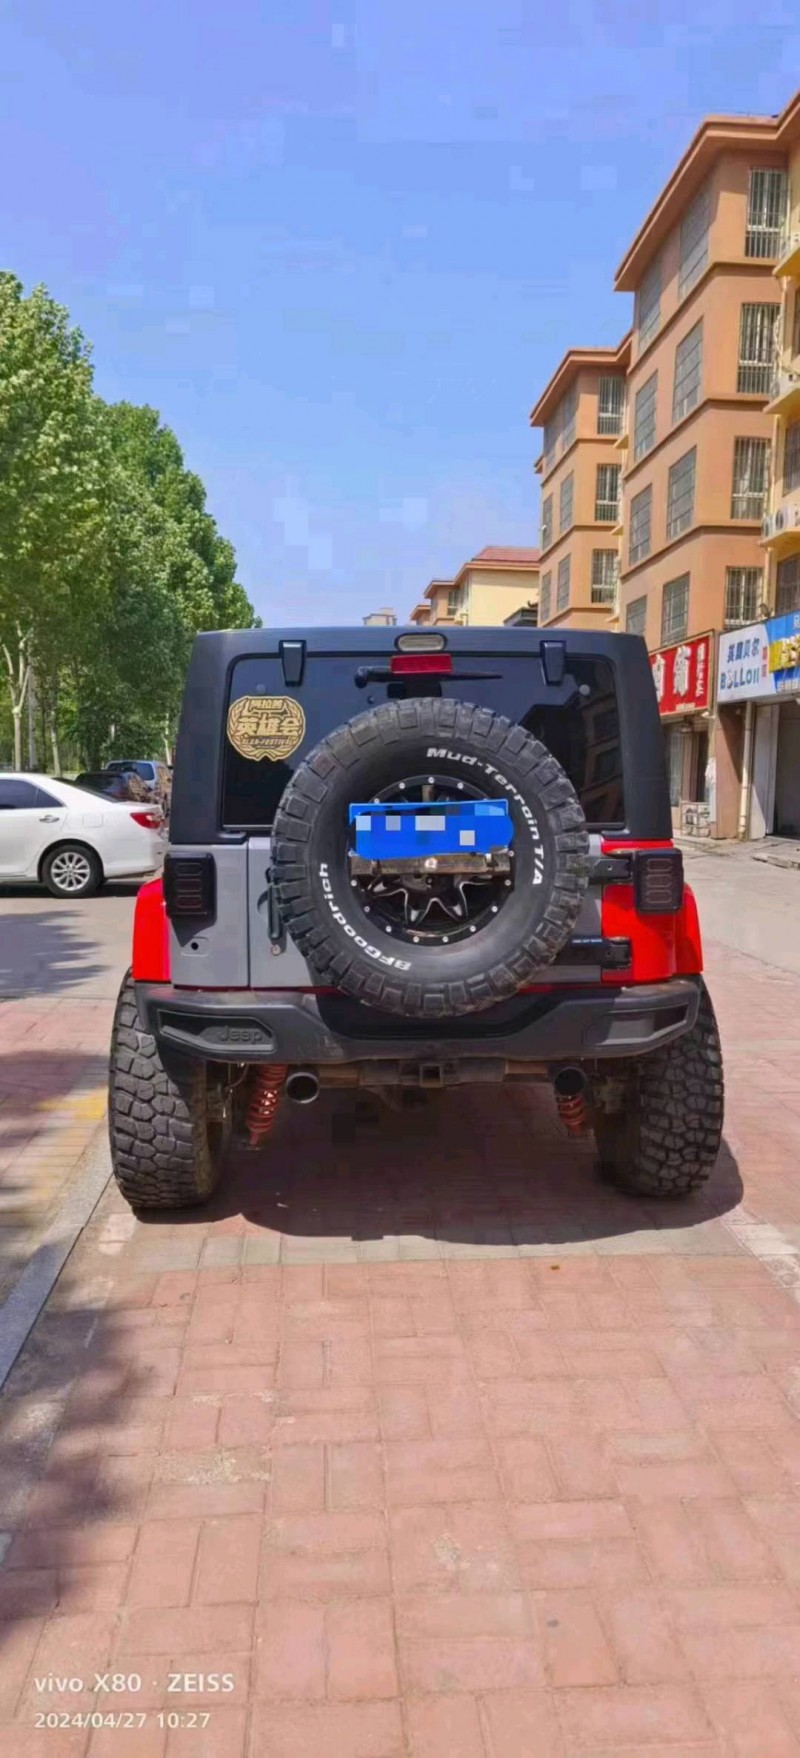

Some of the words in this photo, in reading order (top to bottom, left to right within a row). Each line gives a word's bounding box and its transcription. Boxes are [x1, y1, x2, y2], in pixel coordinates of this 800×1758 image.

[237, 713, 299, 736] 英雄会
[532, 844, 545, 886] T/A
[319, 863, 412, 971] BFGoodrich
[219, 1025, 263, 1045] Jeep
